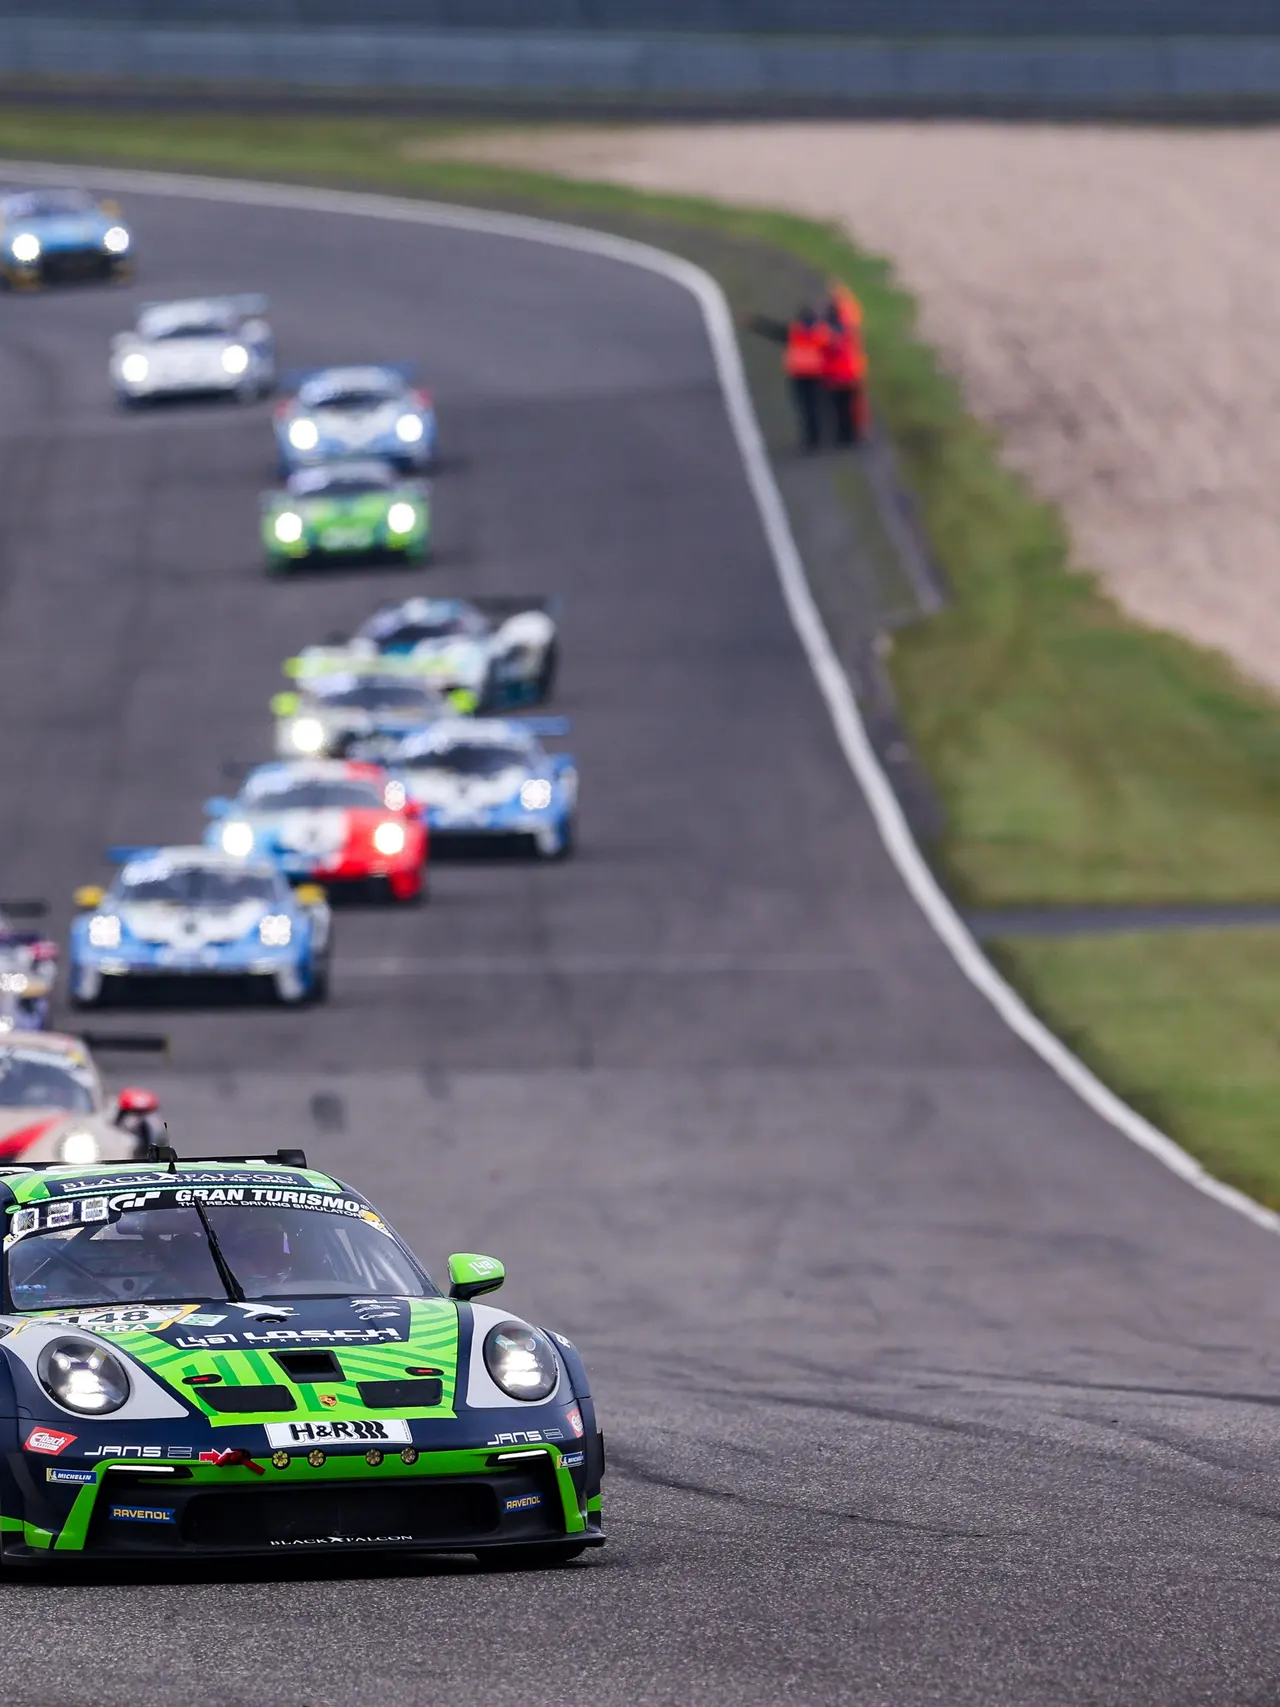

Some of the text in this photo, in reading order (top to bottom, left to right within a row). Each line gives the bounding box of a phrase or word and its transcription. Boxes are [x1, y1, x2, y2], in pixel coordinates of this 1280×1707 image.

[60, 1173, 294, 1189] BLACK FALCON
[175, 1189, 360, 1213] GRAN TURISMO
[58, 1310, 150, 1325] 148
[243, 1327, 401, 1341] LOSCH
[290, 1421, 354, 1441] H&R
[487, 1430, 543, 1446] JANS
[29, 1432, 68, 1451] Eibach
[84, 1446, 162, 1457] JANS
[57, 1472, 92, 1481] MICHELIN
[506, 1496, 541, 1510] RAVENOL
[113, 1508, 170, 1520] RAVENOL
